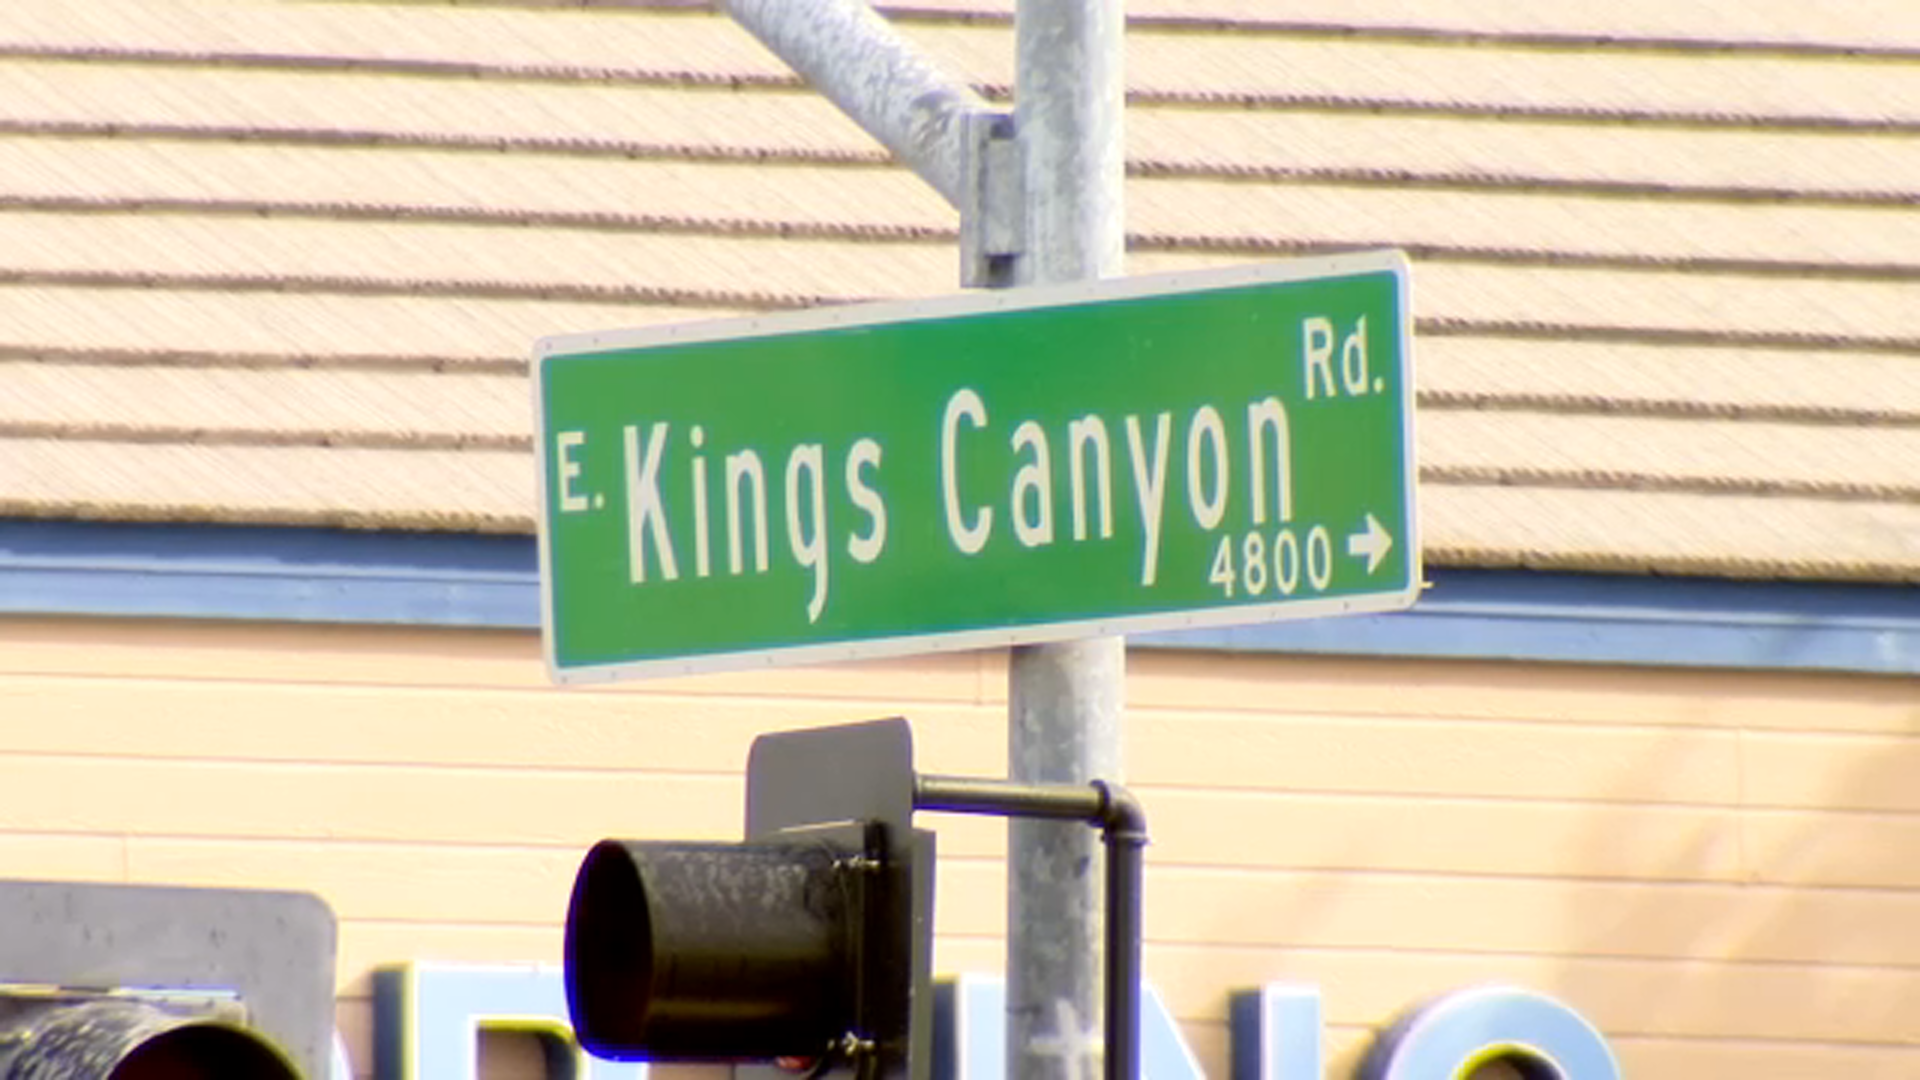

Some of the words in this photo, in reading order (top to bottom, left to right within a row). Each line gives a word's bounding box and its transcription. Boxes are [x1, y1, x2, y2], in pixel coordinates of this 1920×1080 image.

[556, 430, 605, 513] E.
[622, 422, 888, 624] Kings
[941, 388, 1293, 587] Canyon
[1302, 315, 1385, 400] Rd.
[1208, 525, 1333, 598] 4800
